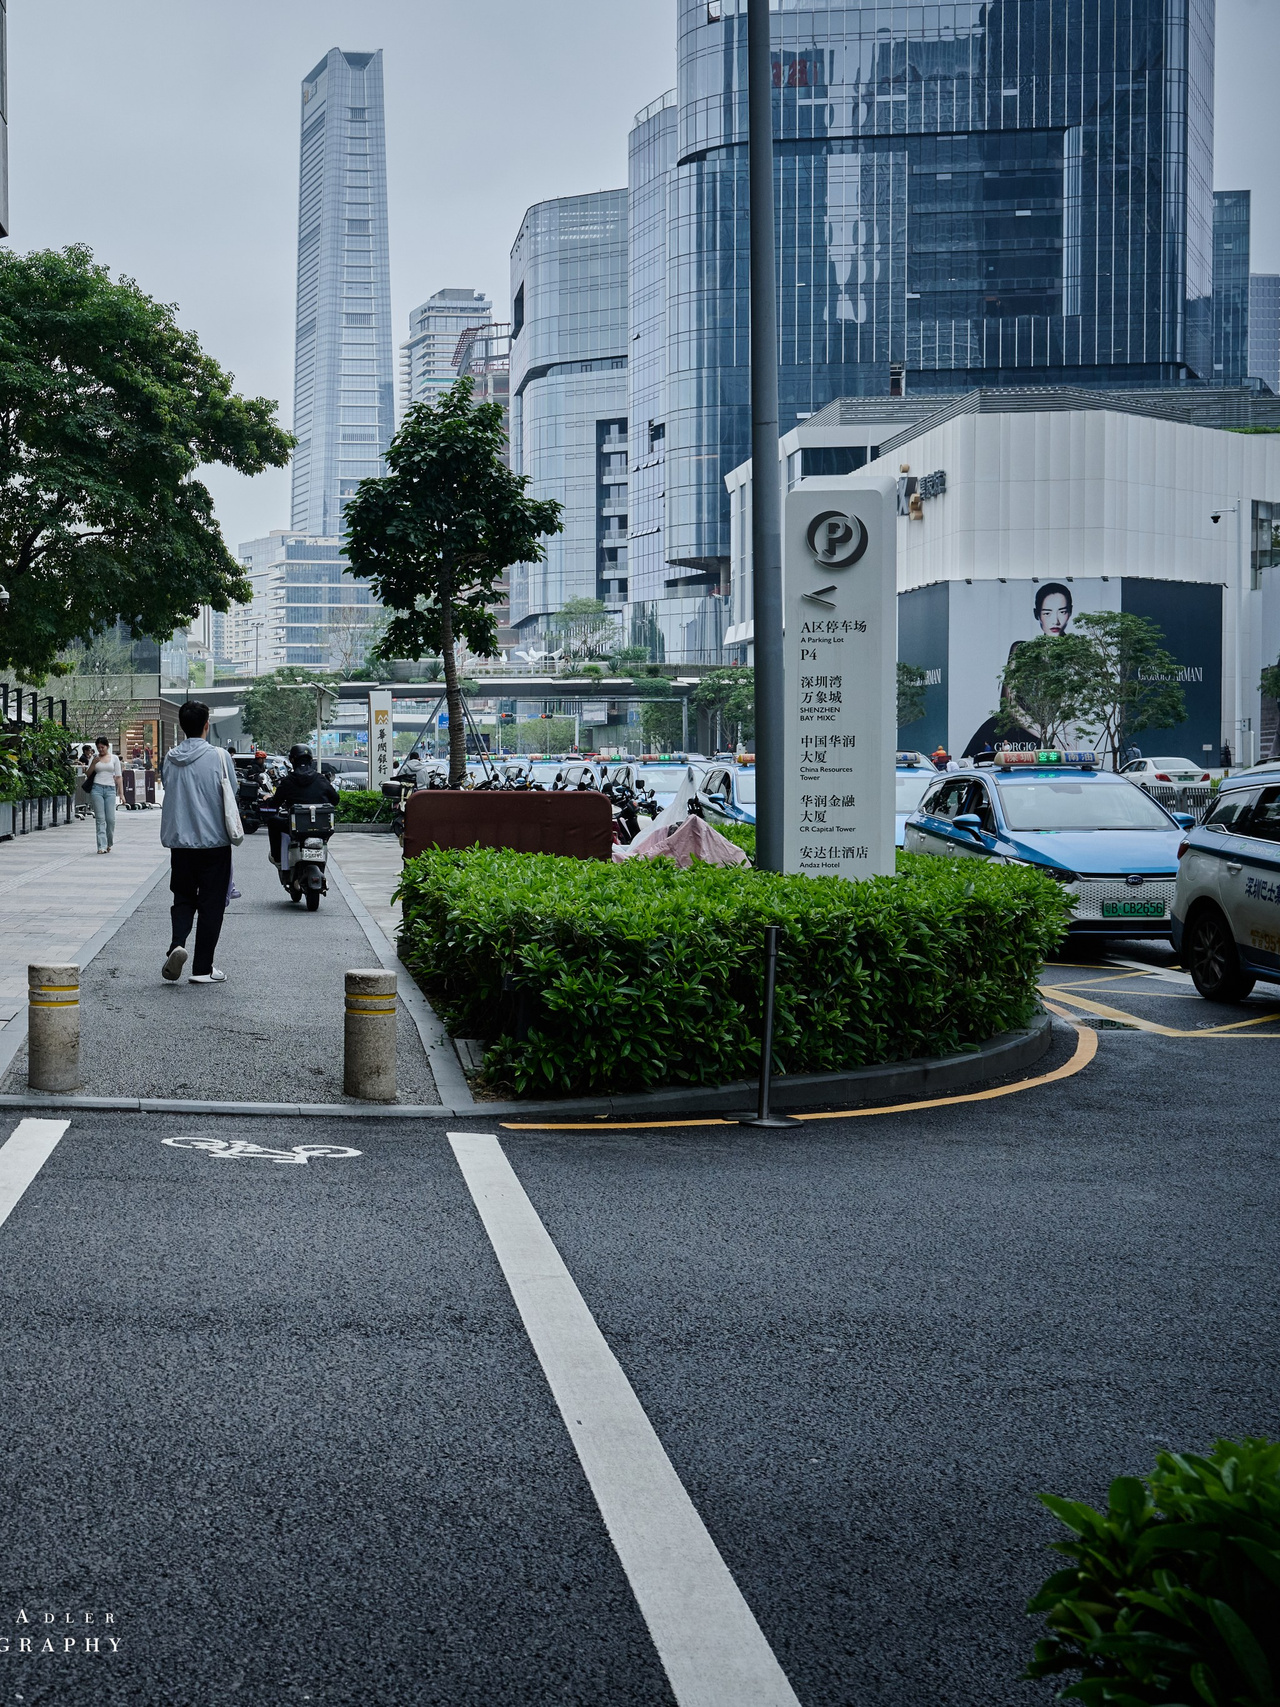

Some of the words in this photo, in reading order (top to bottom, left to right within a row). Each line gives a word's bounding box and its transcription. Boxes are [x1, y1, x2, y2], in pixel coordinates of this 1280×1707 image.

[800, 620, 867, 634] A区停车场
[800, 648, 817, 661] P4
[800, 675, 842, 689] 深圳湾
[800, 691, 842, 704] 万象城
[800, 735, 856, 748] 中国华润
[800, 750, 827, 764] 大厦
[1006, 753, 1034, 762] 深圳
[1038, 752, 1058, 762] 空车
[1067, 753, 1094, 762] 南油
[800, 794, 856, 808] 华润金融
[800, 810, 827, 823] 大厦
[811, 826, 834, 834] Capital
[799, 846, 869, 859] 安达仕酒店
